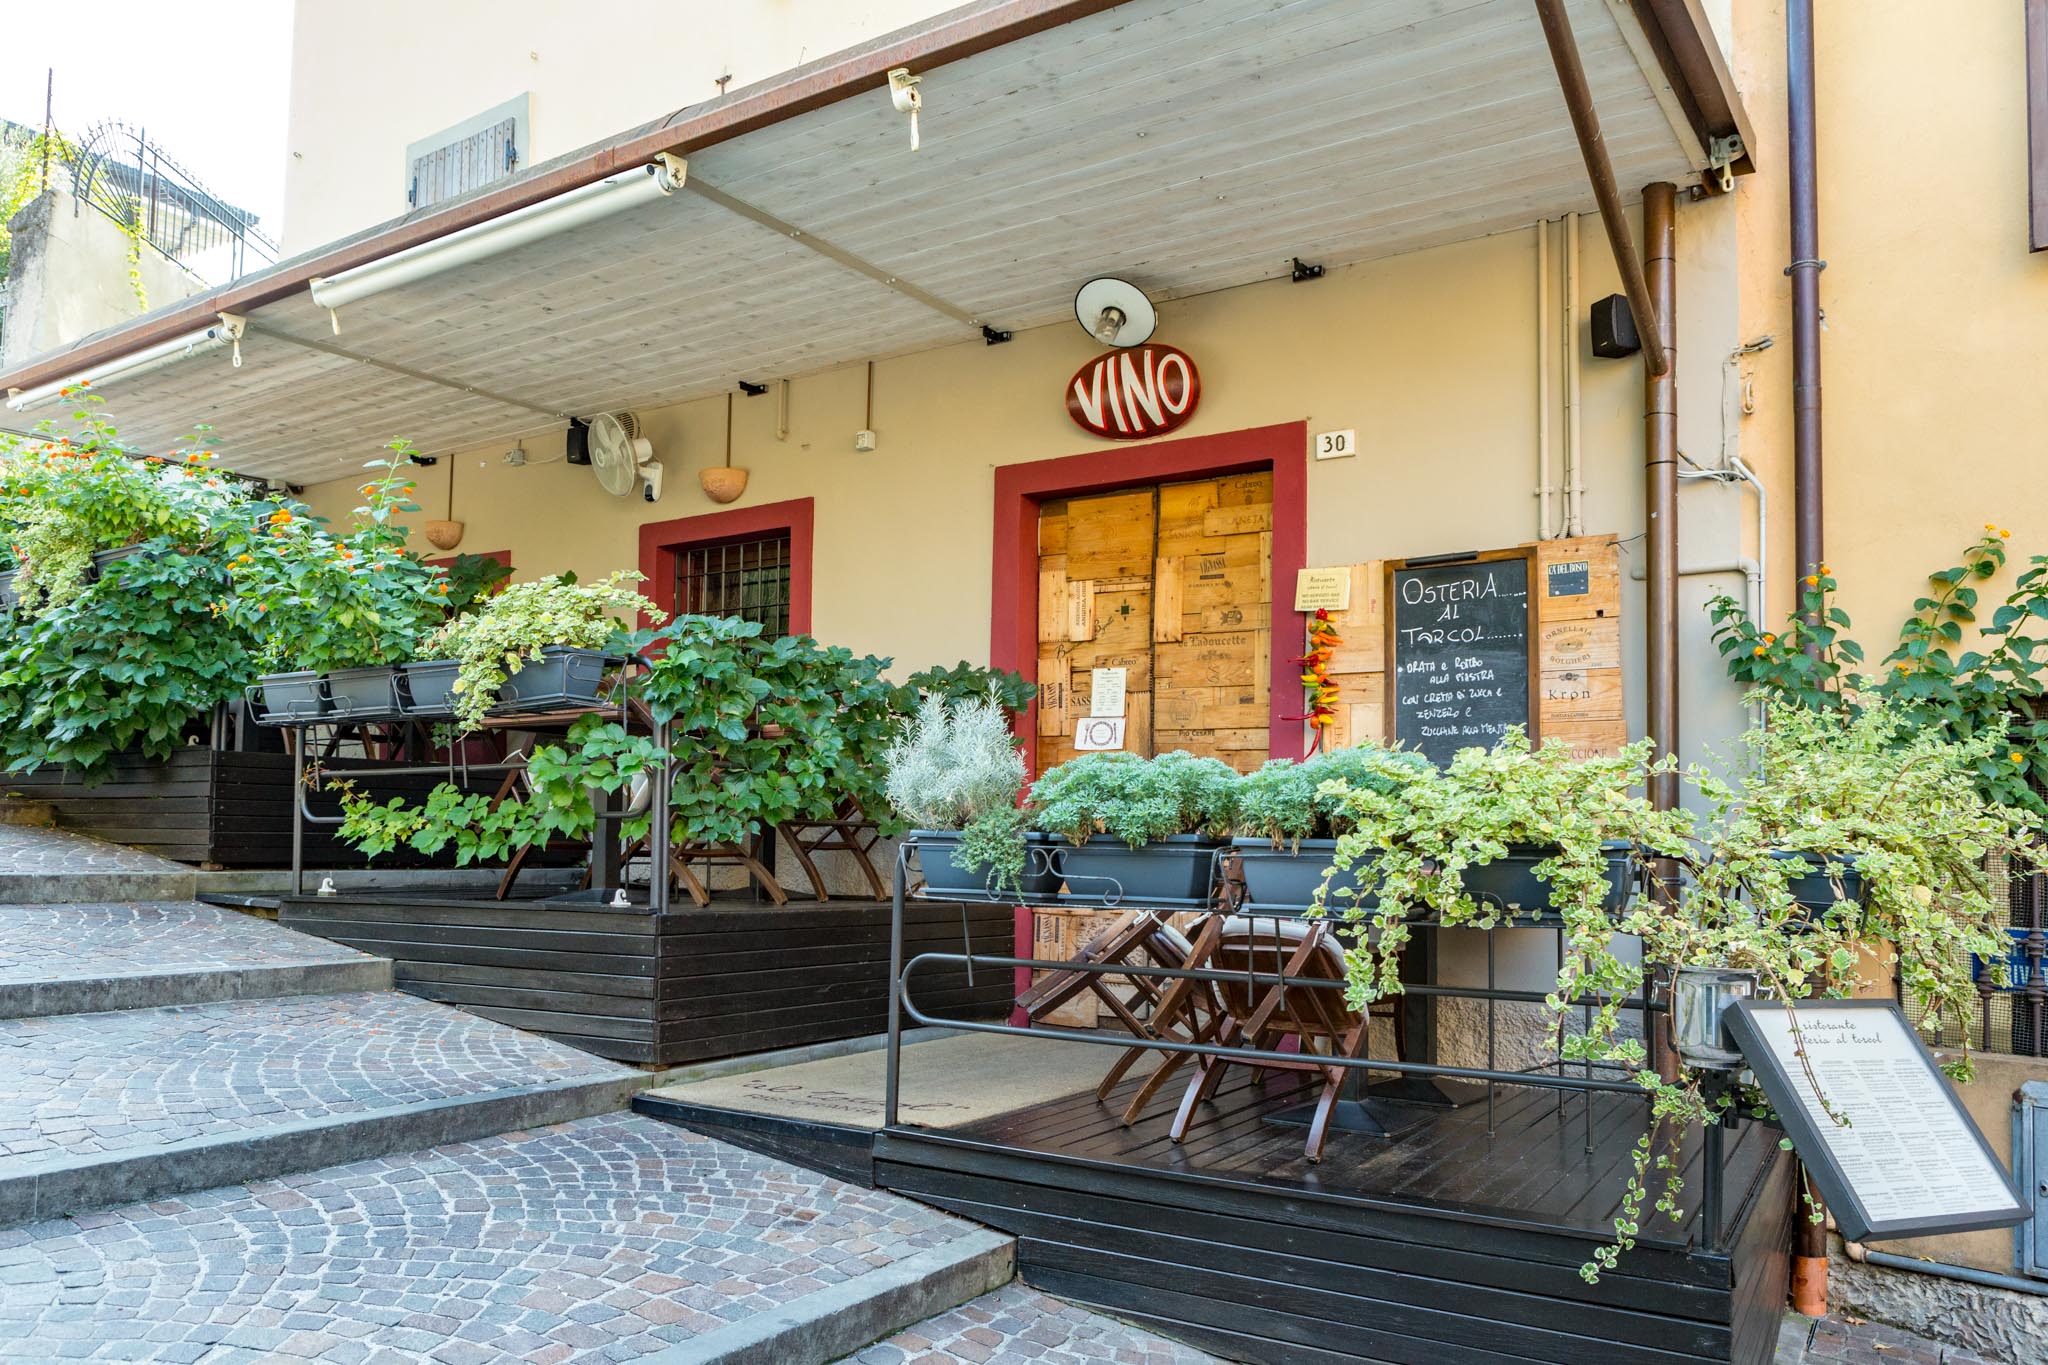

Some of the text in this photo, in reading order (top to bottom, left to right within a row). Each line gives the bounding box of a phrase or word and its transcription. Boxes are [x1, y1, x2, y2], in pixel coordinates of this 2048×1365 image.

[1074, 350, 1194, 432] VINO
[1323, 435, 1345, 453] 30
[1557, 563, 1569, 574] DEL
[1569, 562, 1588, 573] BOSCO
[1402, 572, 1497, 604] OSTERIA
[1437, 604, 1459, 622] AL
[1545, 625, 1593, 641] ORNELLAIA
[1549, 652, 1592, 665] BOLGHERI
[1430, 674, 1450, 685] ALLA
[1802, 1019, 1857, 1031] ristorante
[1836, 1033, 1848, 1045] al
[1852, 1032, 1883, 1045] torcol
